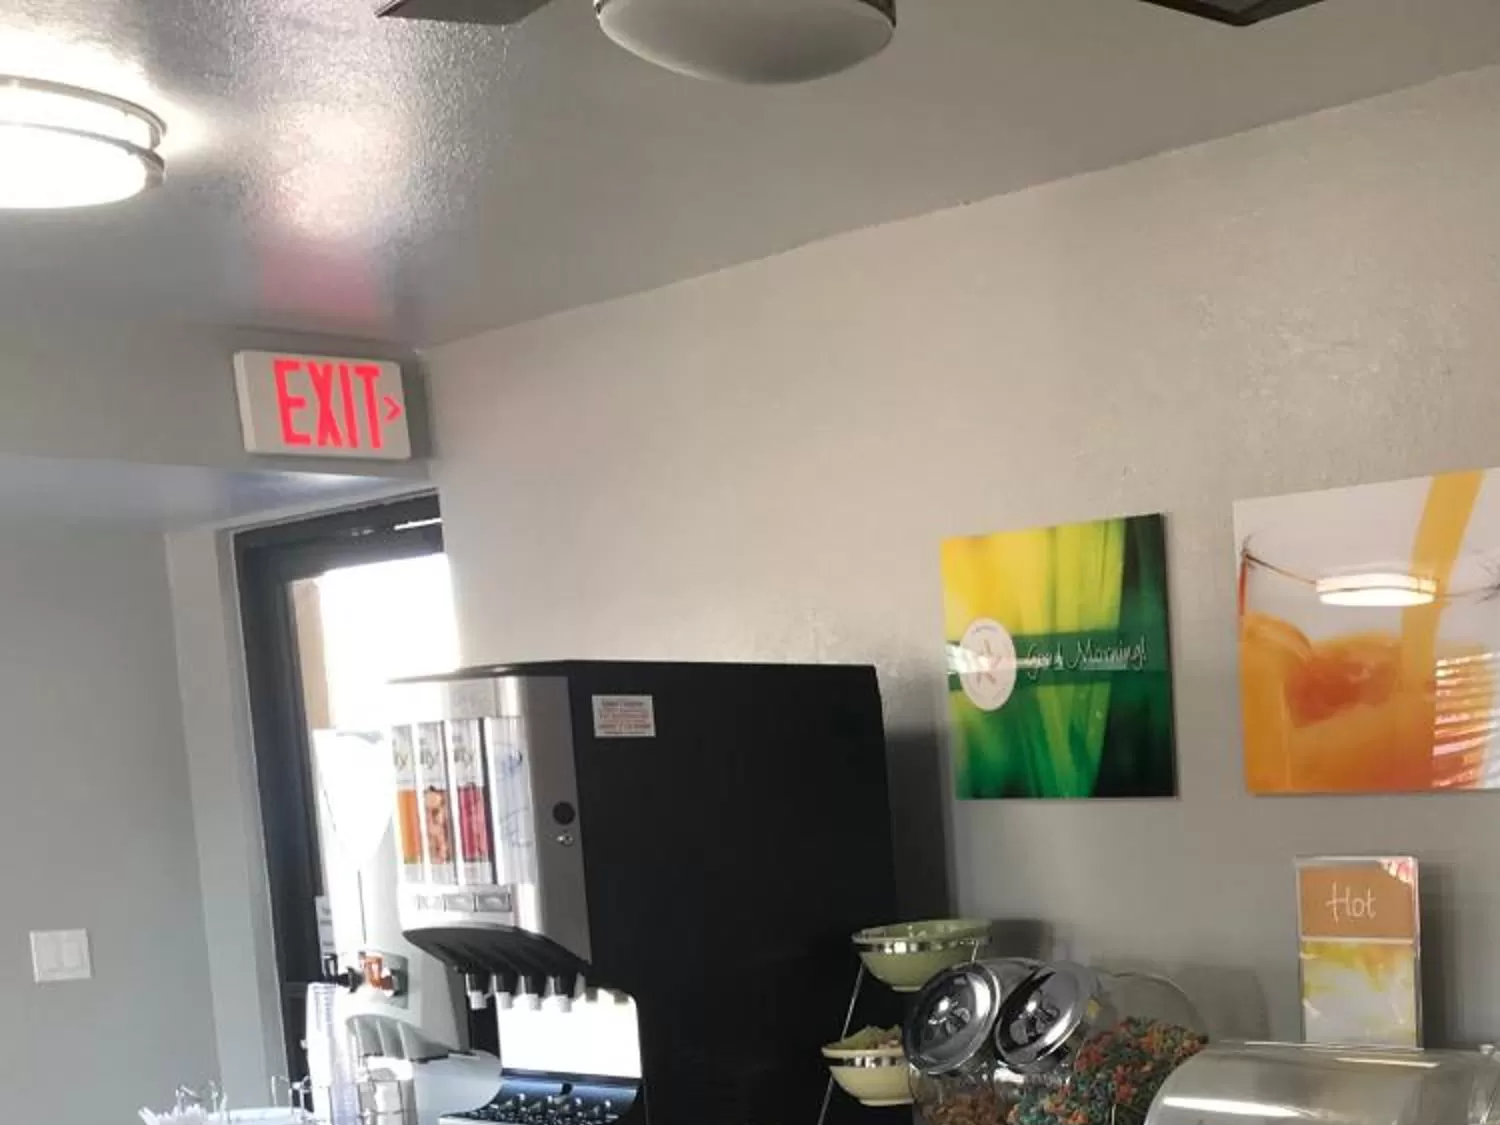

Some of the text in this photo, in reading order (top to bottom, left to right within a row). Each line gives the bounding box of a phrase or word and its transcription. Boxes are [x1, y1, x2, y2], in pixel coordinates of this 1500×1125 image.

[272, 358, 384, 450] EXIT
[1027, 642, 1064, 680] Good
[1325, 881, 1377, 925] Hot
